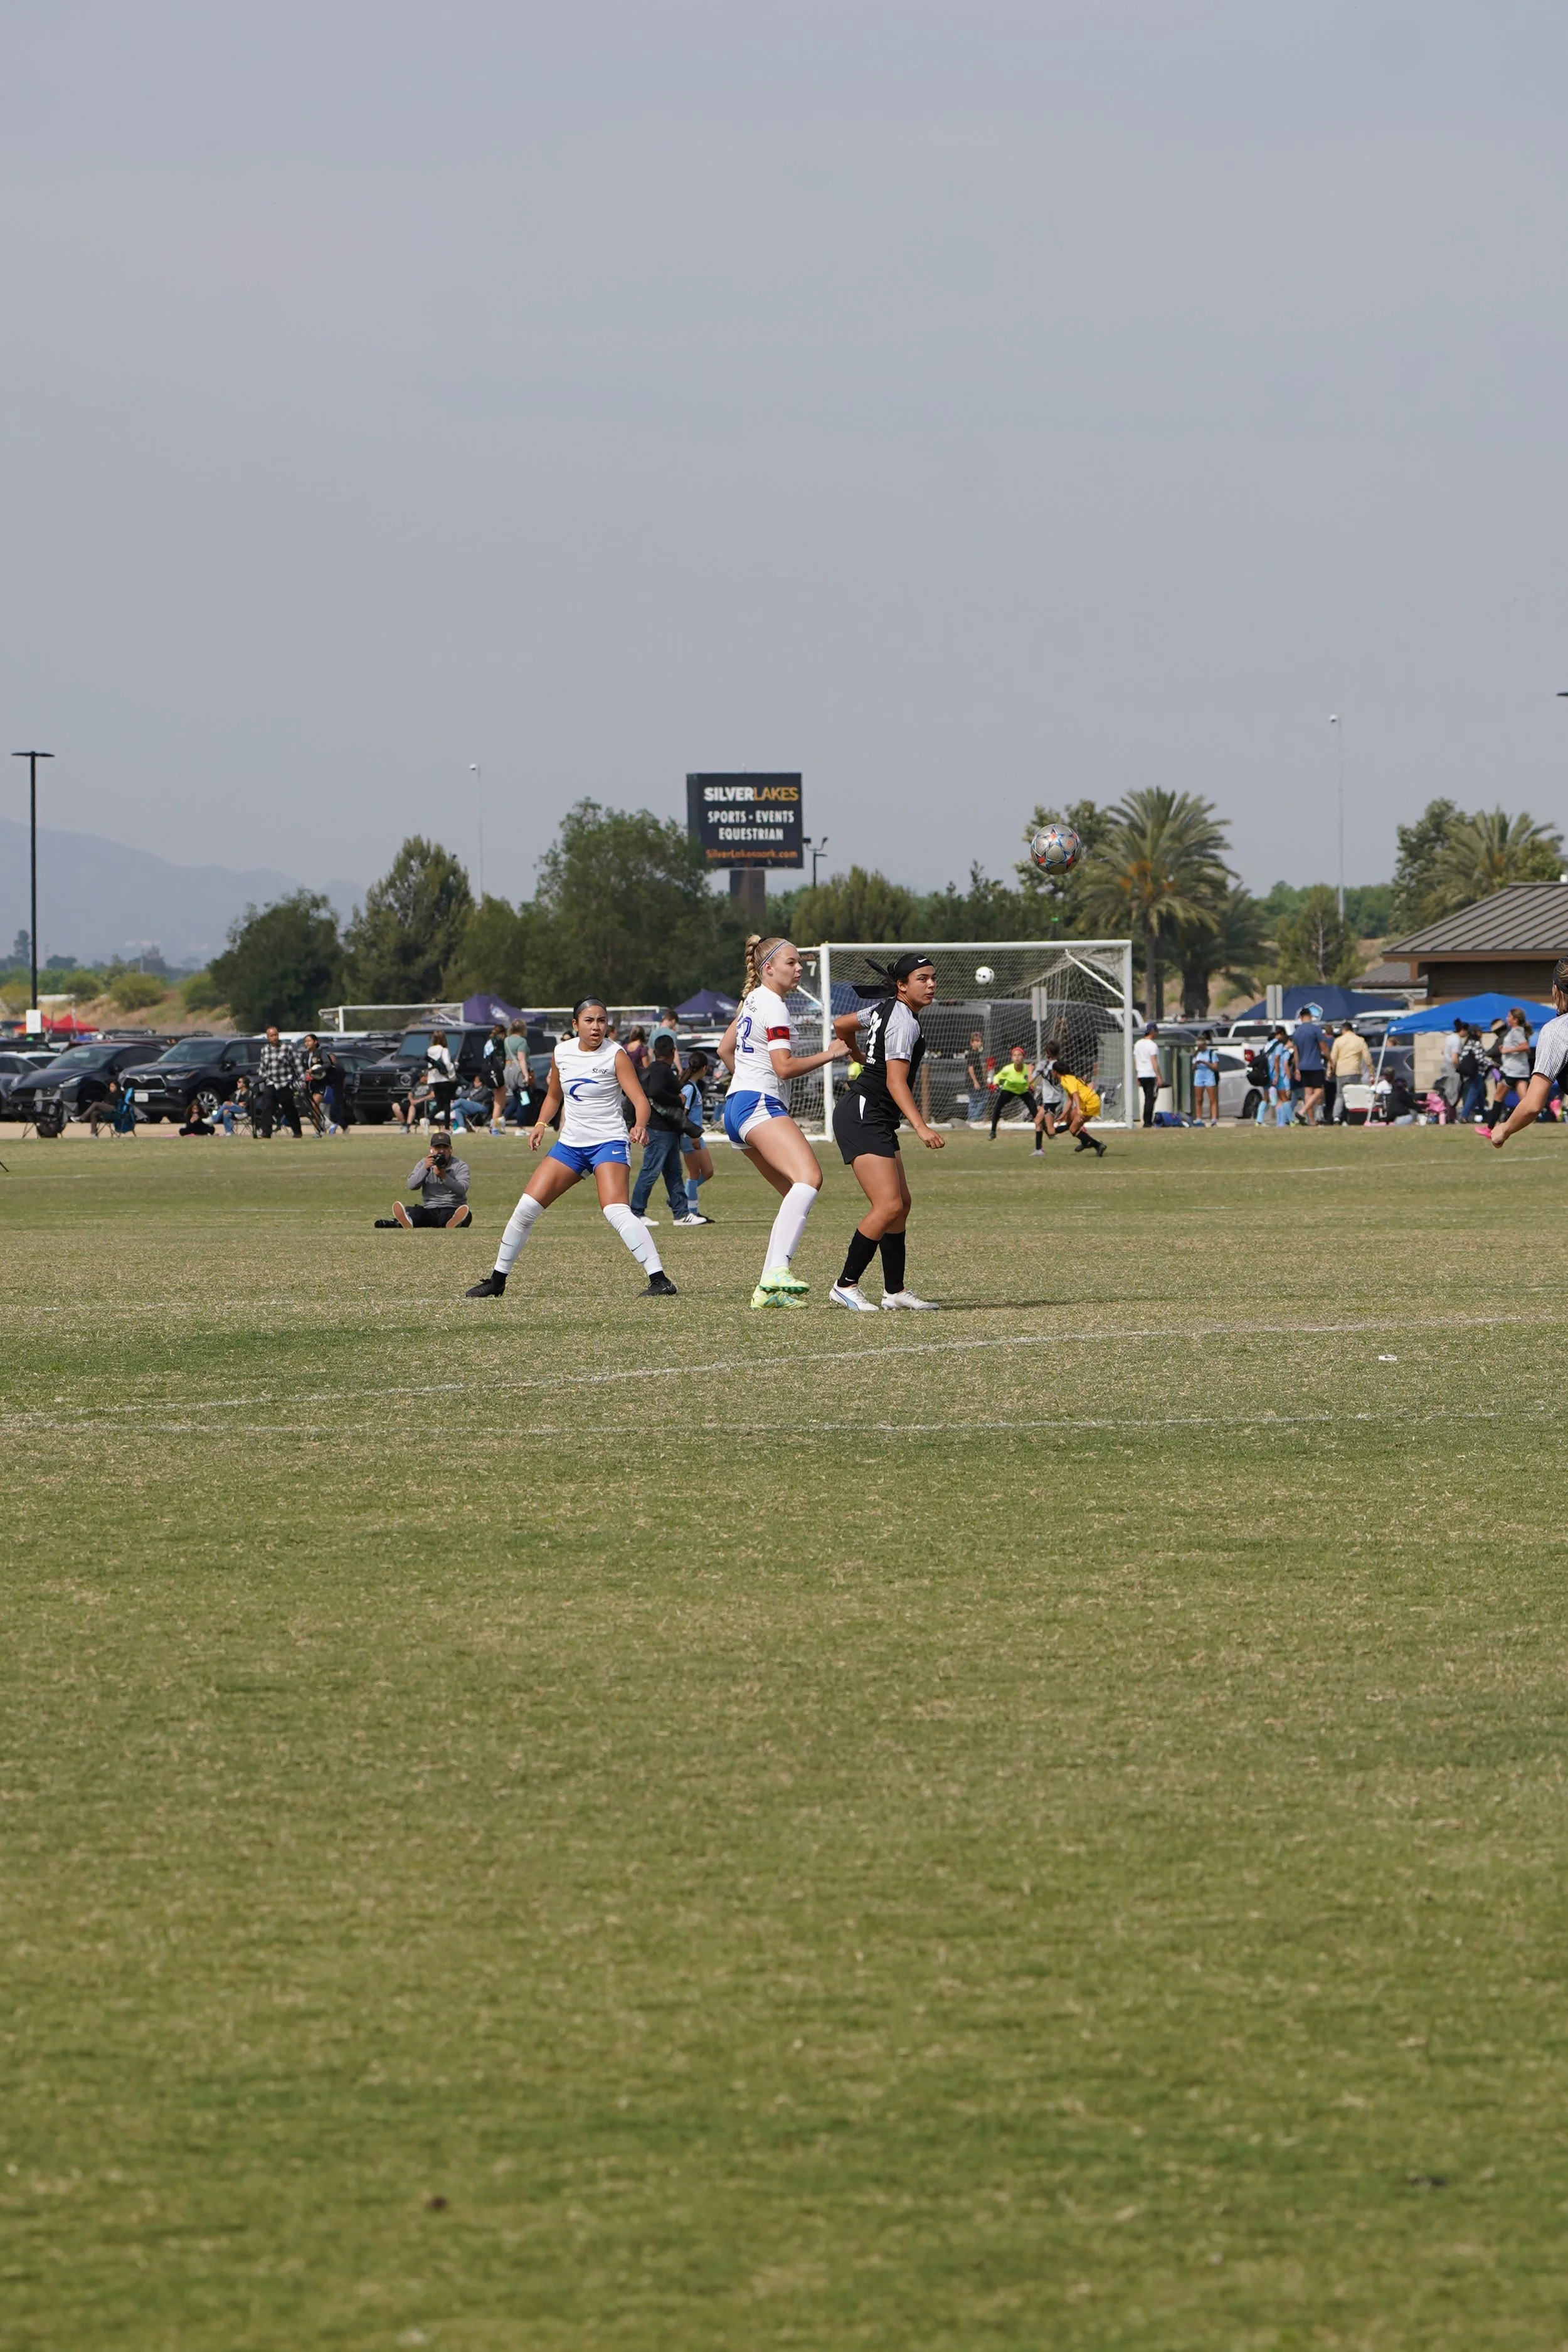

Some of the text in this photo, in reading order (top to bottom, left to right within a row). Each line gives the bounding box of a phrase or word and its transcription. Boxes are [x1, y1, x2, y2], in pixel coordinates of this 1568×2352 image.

[703, 787, 798, 802] SILVERLAKES
[707, 810, 795, 824] SPORTS EVENTS
[718, 827, 784, 840] EQUESTRIAN
[806, 961, 817, 977] 7
